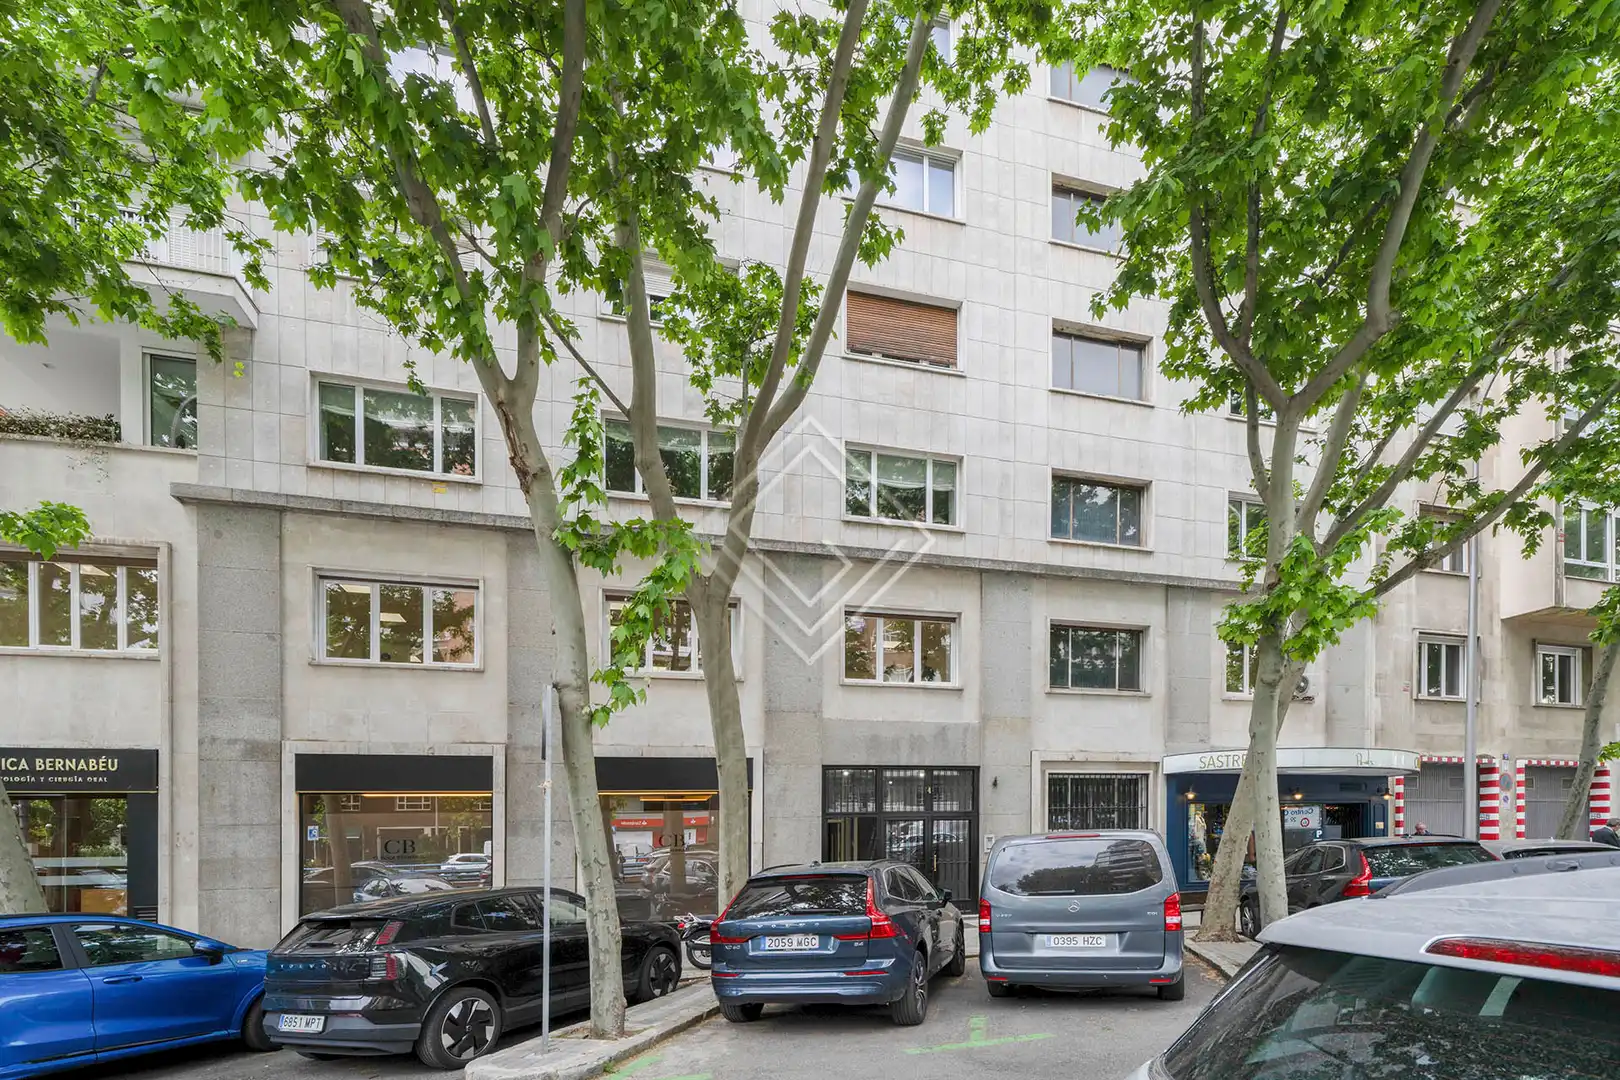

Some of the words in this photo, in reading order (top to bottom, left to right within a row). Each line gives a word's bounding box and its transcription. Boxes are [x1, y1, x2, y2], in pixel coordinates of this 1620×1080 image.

[35, 755, 119, 771] BERNABÉU
[0, 775, 36, 783] OLOGÍA
[384, 839, 416, 854] CB
[767, 937, 793, 948] 2059
[796, 936, 817, 947] MGC
[1053, 936, 1079, 946] 0395
[1082, 935, 1103, 946] HZC
[283, 1015, 303, 1028] 6851
[305, 1017, 322, 1029] MPT
